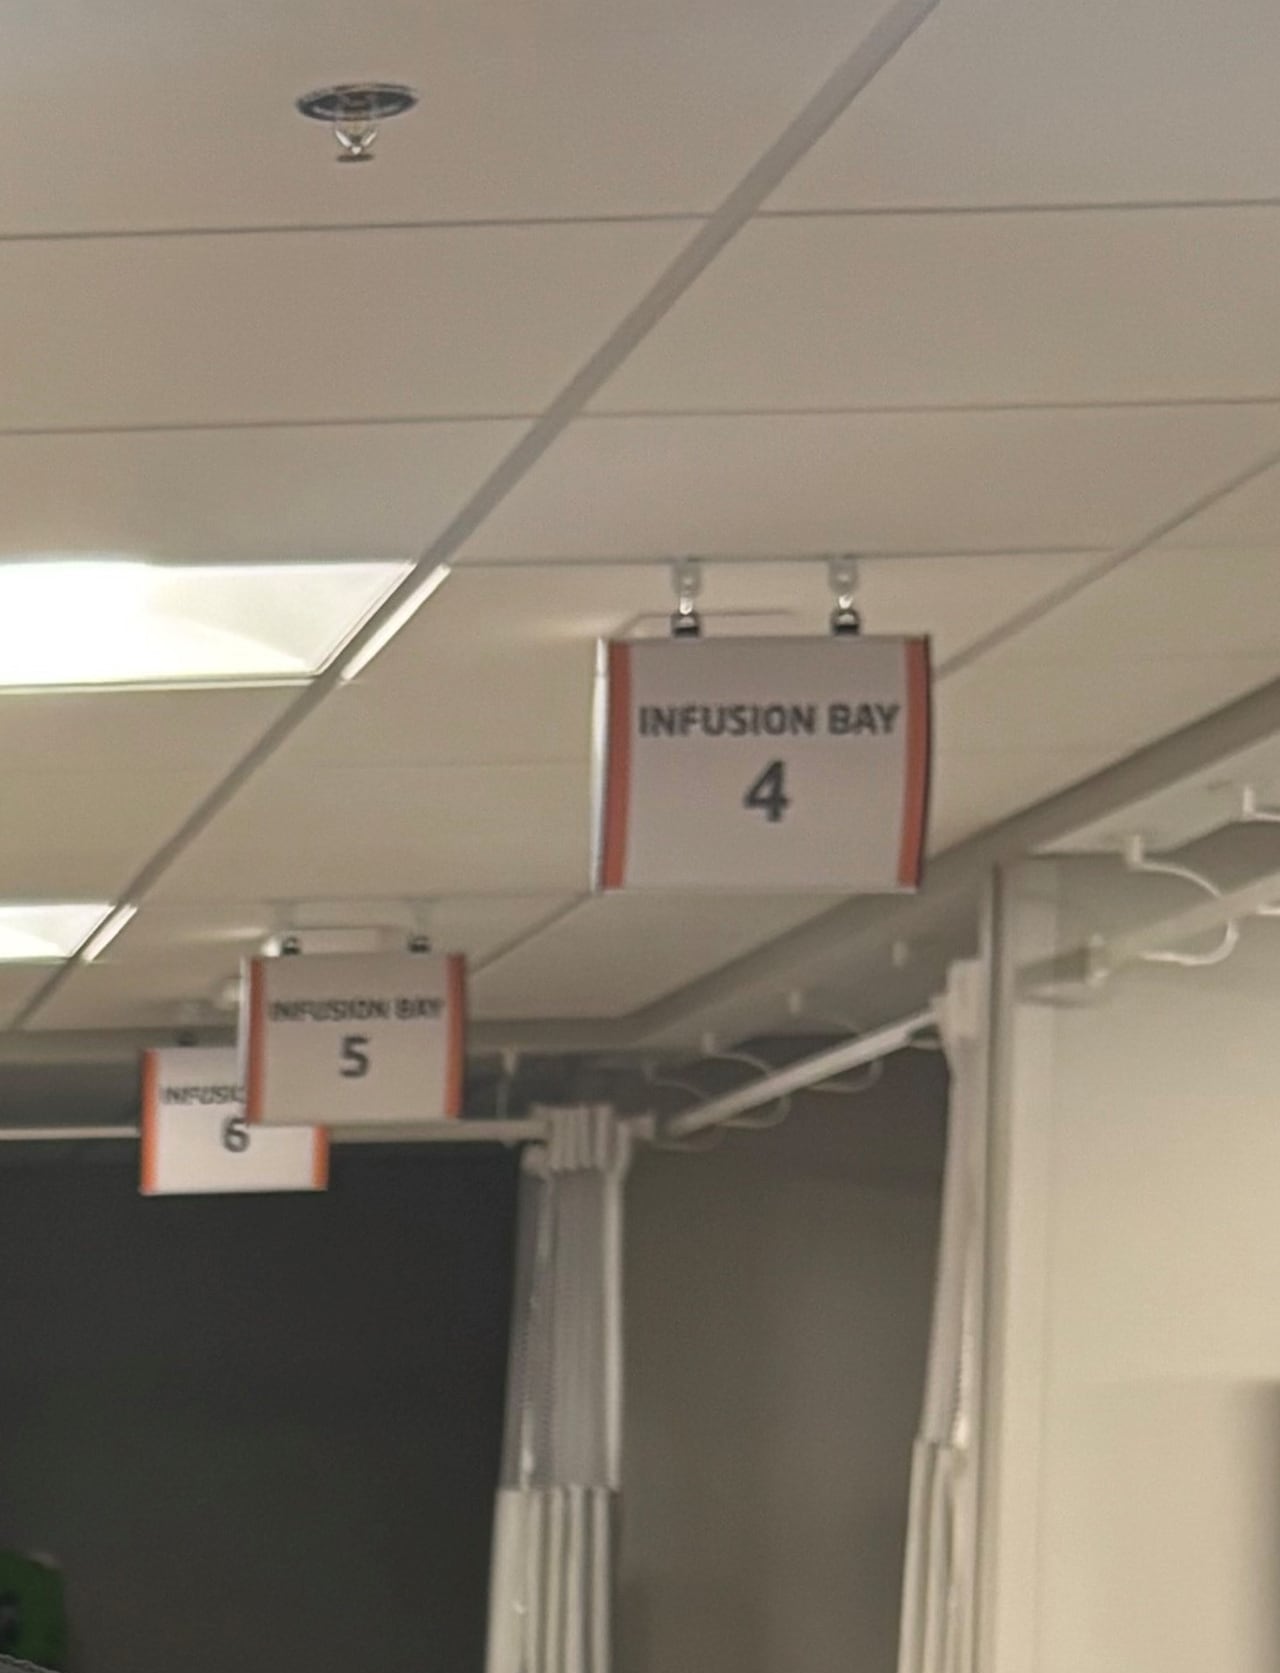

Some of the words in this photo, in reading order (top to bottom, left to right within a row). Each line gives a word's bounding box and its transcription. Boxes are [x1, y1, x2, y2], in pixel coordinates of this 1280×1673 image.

[638, 704, 817, 737] INFUSION
[827, 703, 901, 736] BAY
[743, 758, 790, 823] 4
[269, 1000, 390, 1022] INFUSION
[395, 998, 444, 1021] BAY
[340, 1035, 370, 1078] 5
[162, 1085, 246, 1105] INFUSI
[221, 1116, 250, 1153] 6
